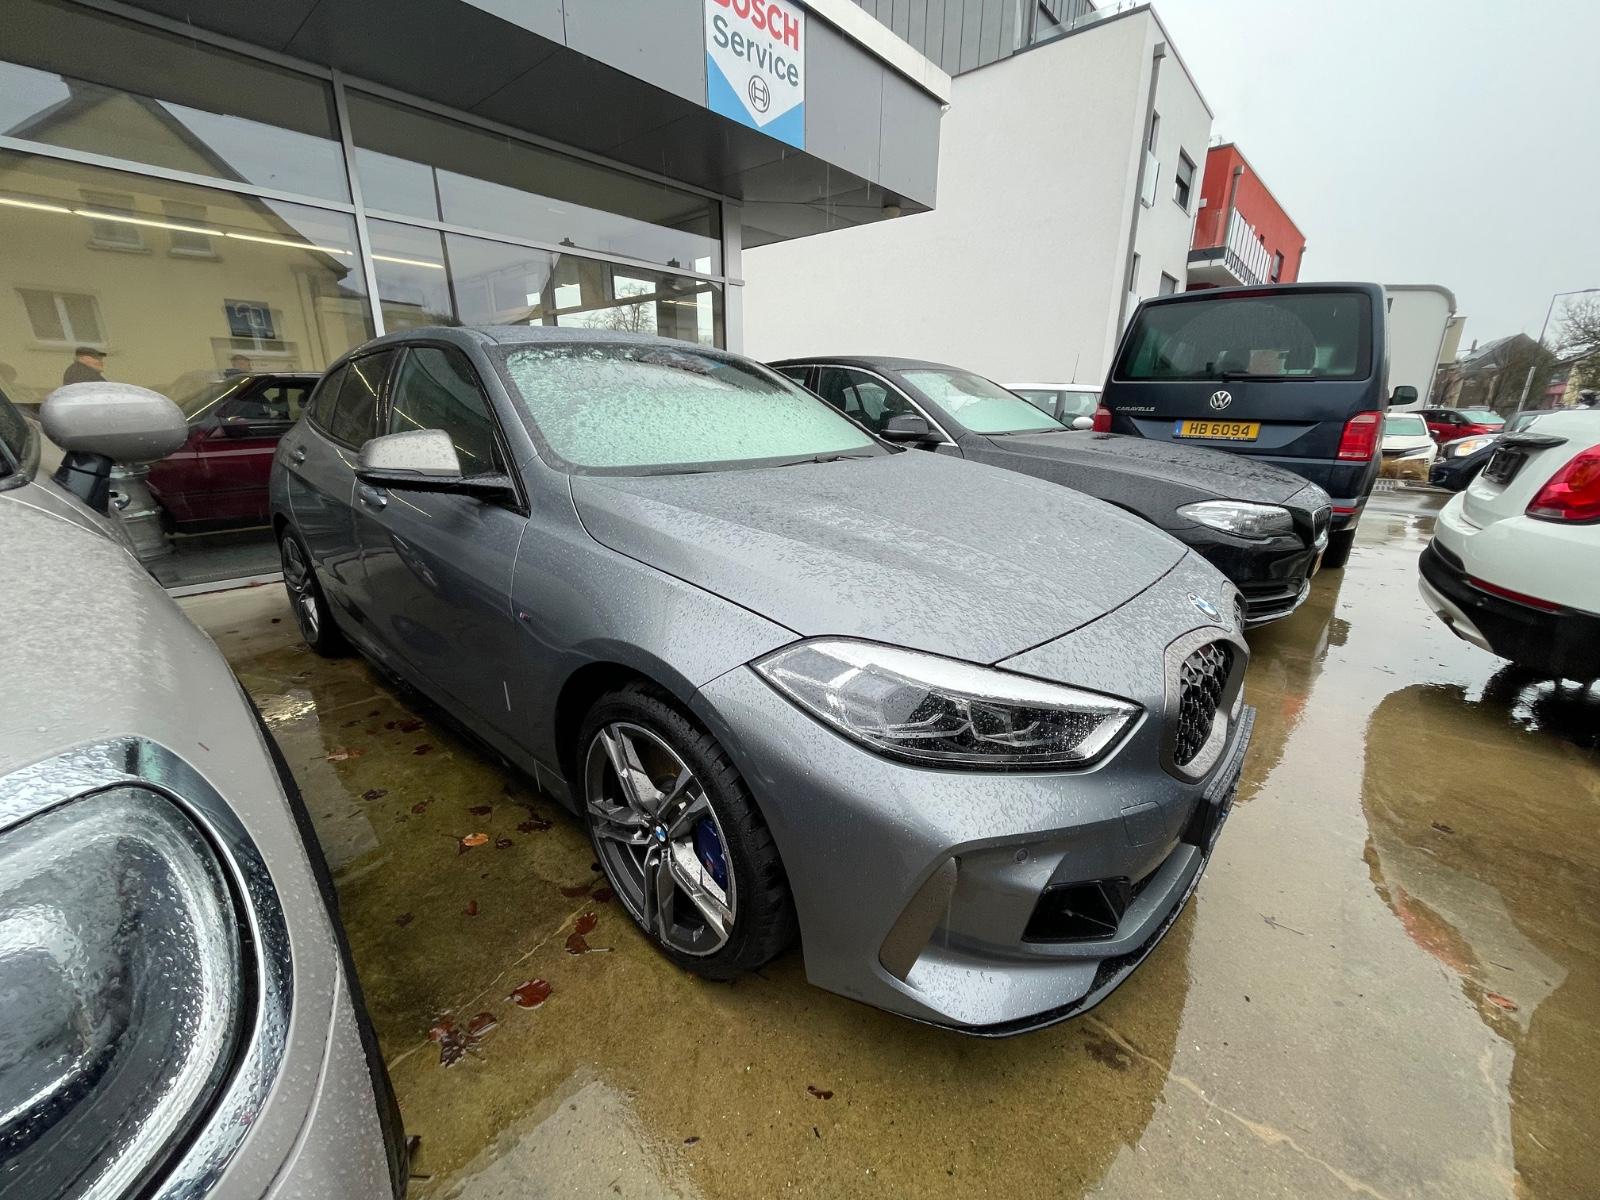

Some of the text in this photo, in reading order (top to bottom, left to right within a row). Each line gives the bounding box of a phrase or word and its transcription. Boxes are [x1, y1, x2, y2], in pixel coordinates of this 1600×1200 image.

[711, 0, 799, 51] OSCH
[713, 14, 799, 87] Service
[1189, 423, 1251, 437] HB 6094
